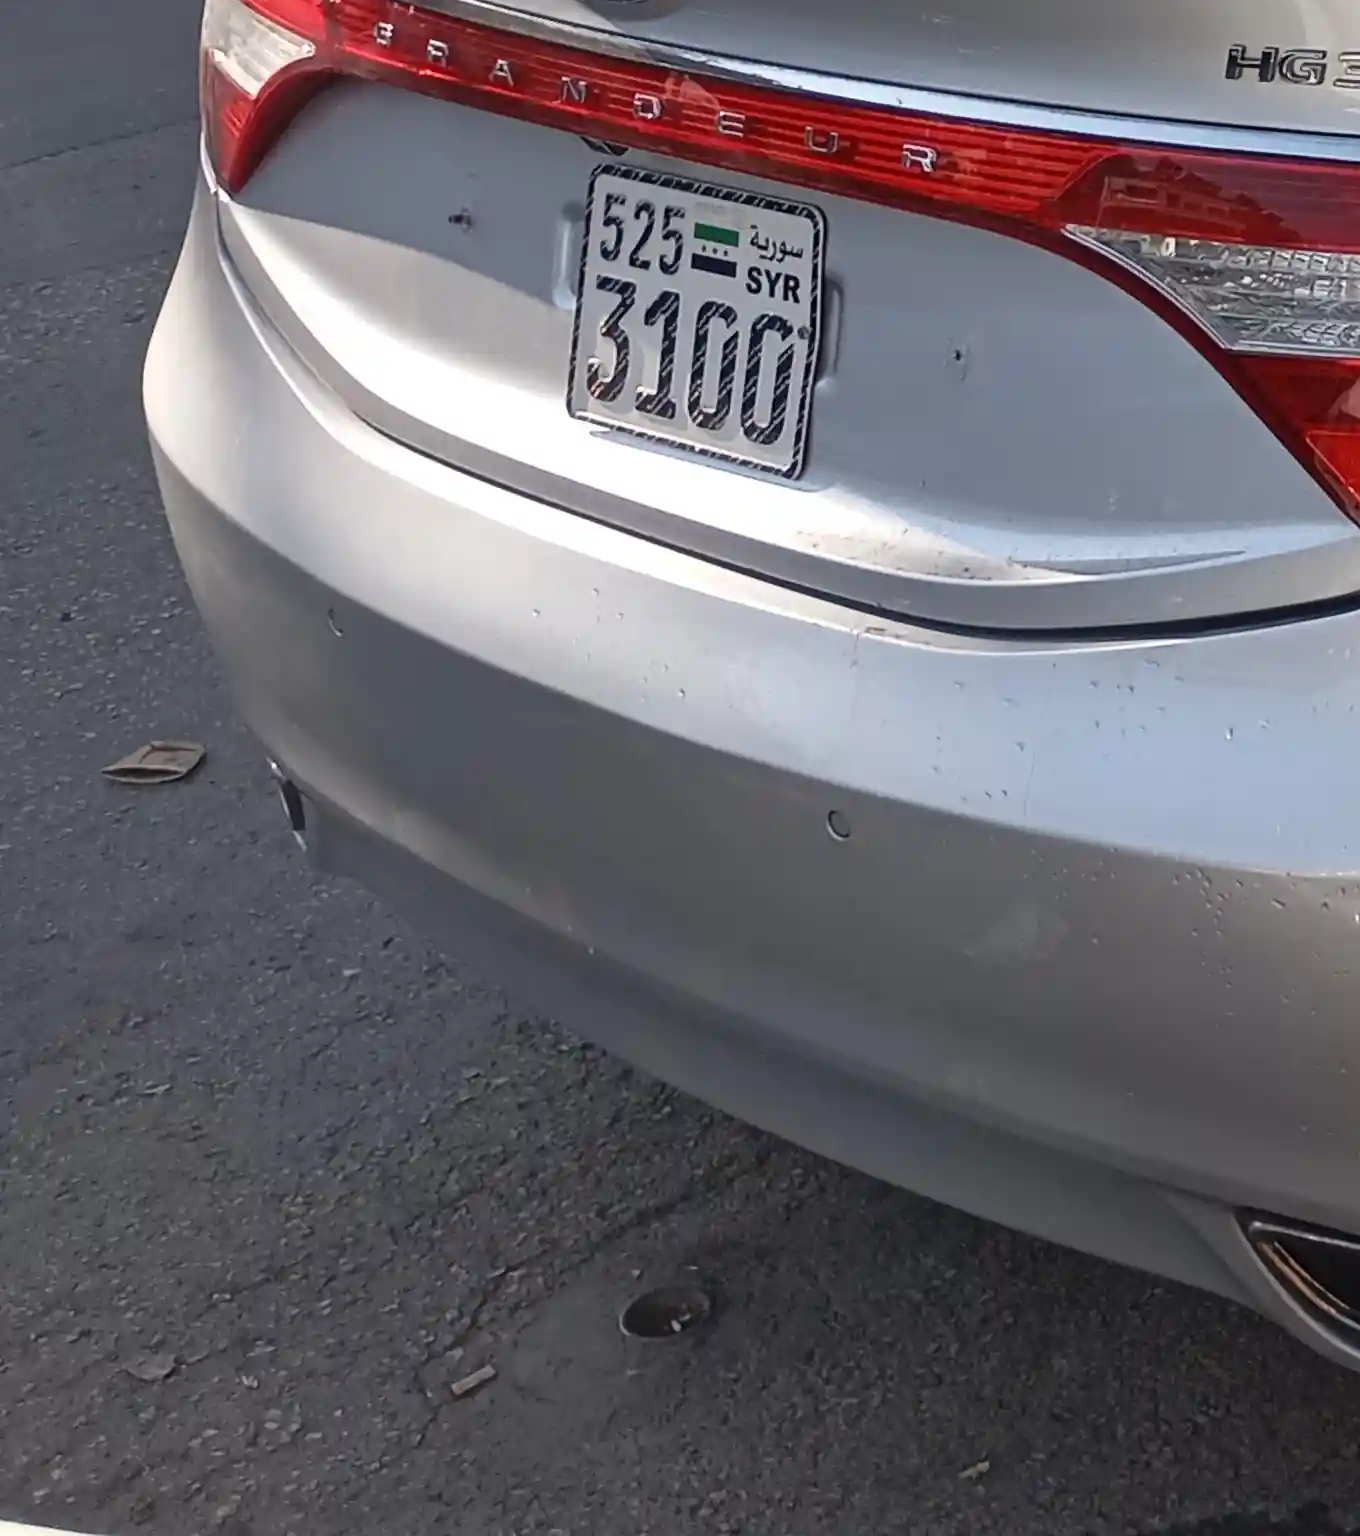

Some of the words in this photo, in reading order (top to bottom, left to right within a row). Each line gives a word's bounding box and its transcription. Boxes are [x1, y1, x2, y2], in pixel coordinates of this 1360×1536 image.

[373, 21, 938, 173] GRANDEUR
[599, 192, 686, 276] 525
[749, 223, 804, 264] سورية
[745, 266, 801, 304] SYR
[586, 274, 797, 446] 3100
